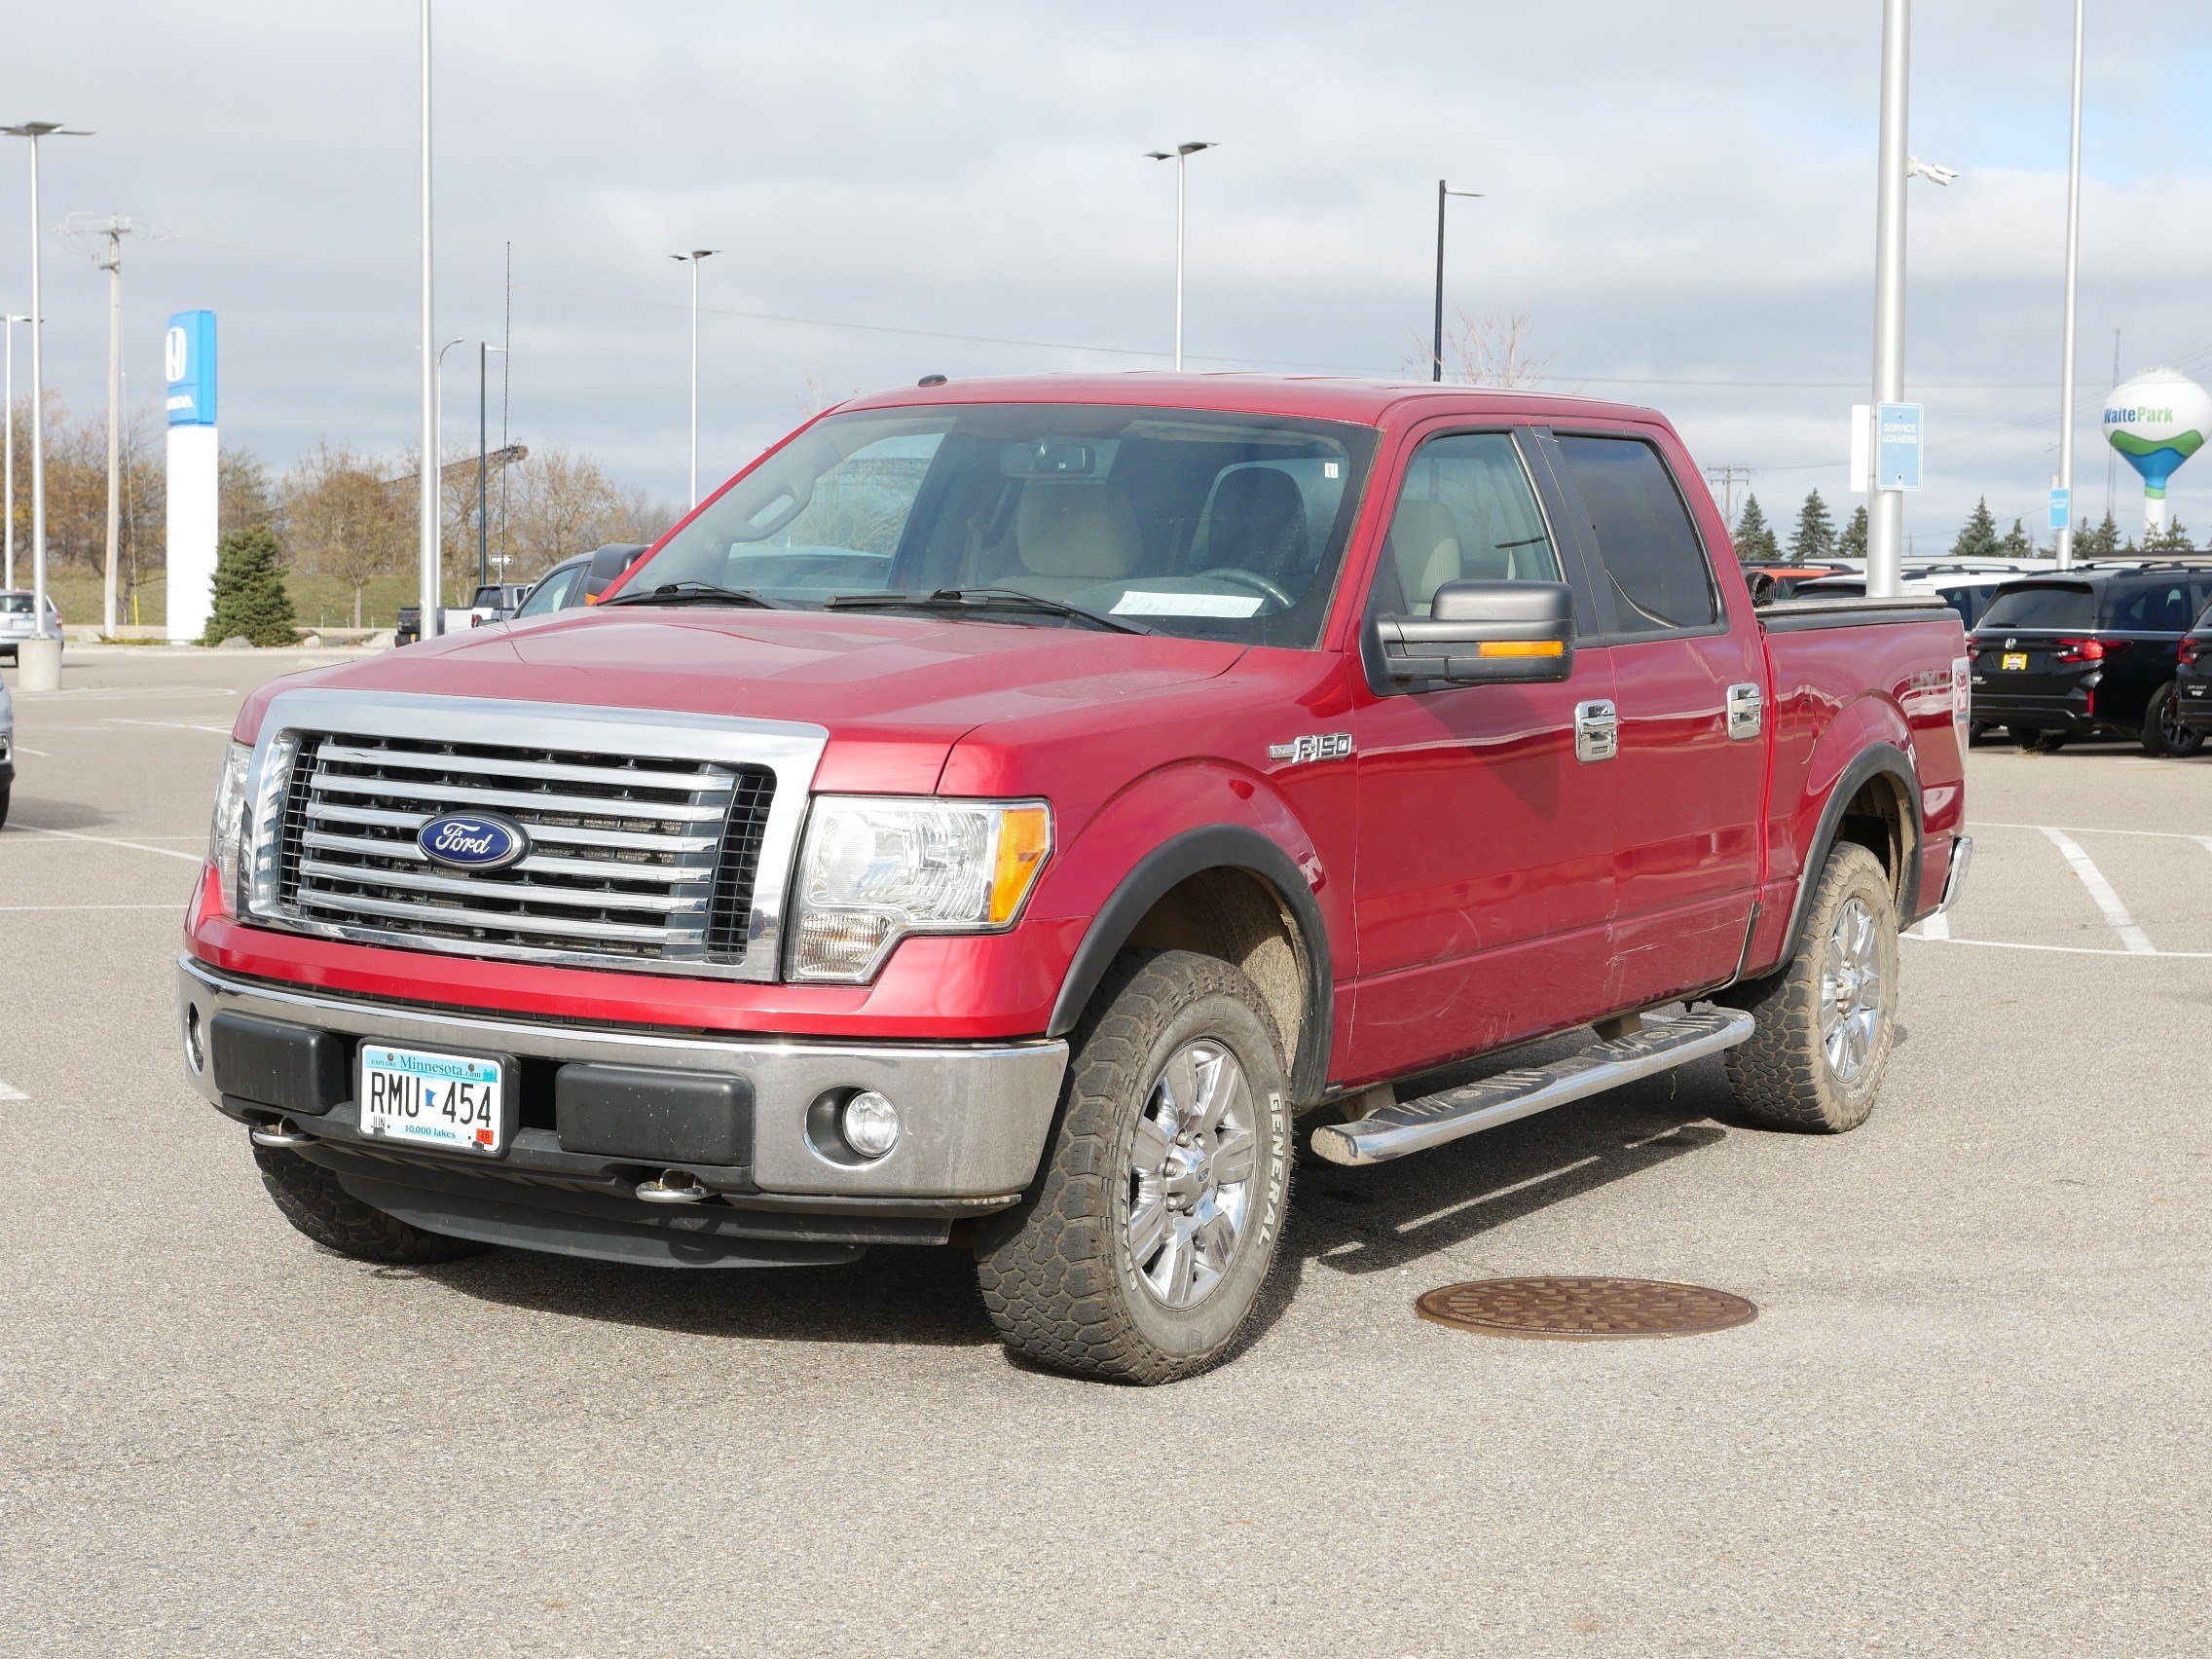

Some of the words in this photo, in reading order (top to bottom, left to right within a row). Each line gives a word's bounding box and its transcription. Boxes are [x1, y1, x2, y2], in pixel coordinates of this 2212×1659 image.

[1884, 423, 1916, 433] SERVICE
[1882, 434, 1918, 444] LOANERS
[435, 823, 494, 854] Ford
[371, 1058, 396, 1068] EXPLORE
[370, 1071, 421, 1118] RMU
[442, 1081, 492, 1128] 454
[404, 1124, 431, 1136] 10,000
[433, 1127, 456, 1139] lakes
[480, 1130, 490, 1139] 26
[1258, 1092, 1284, 1245] GENERAL
